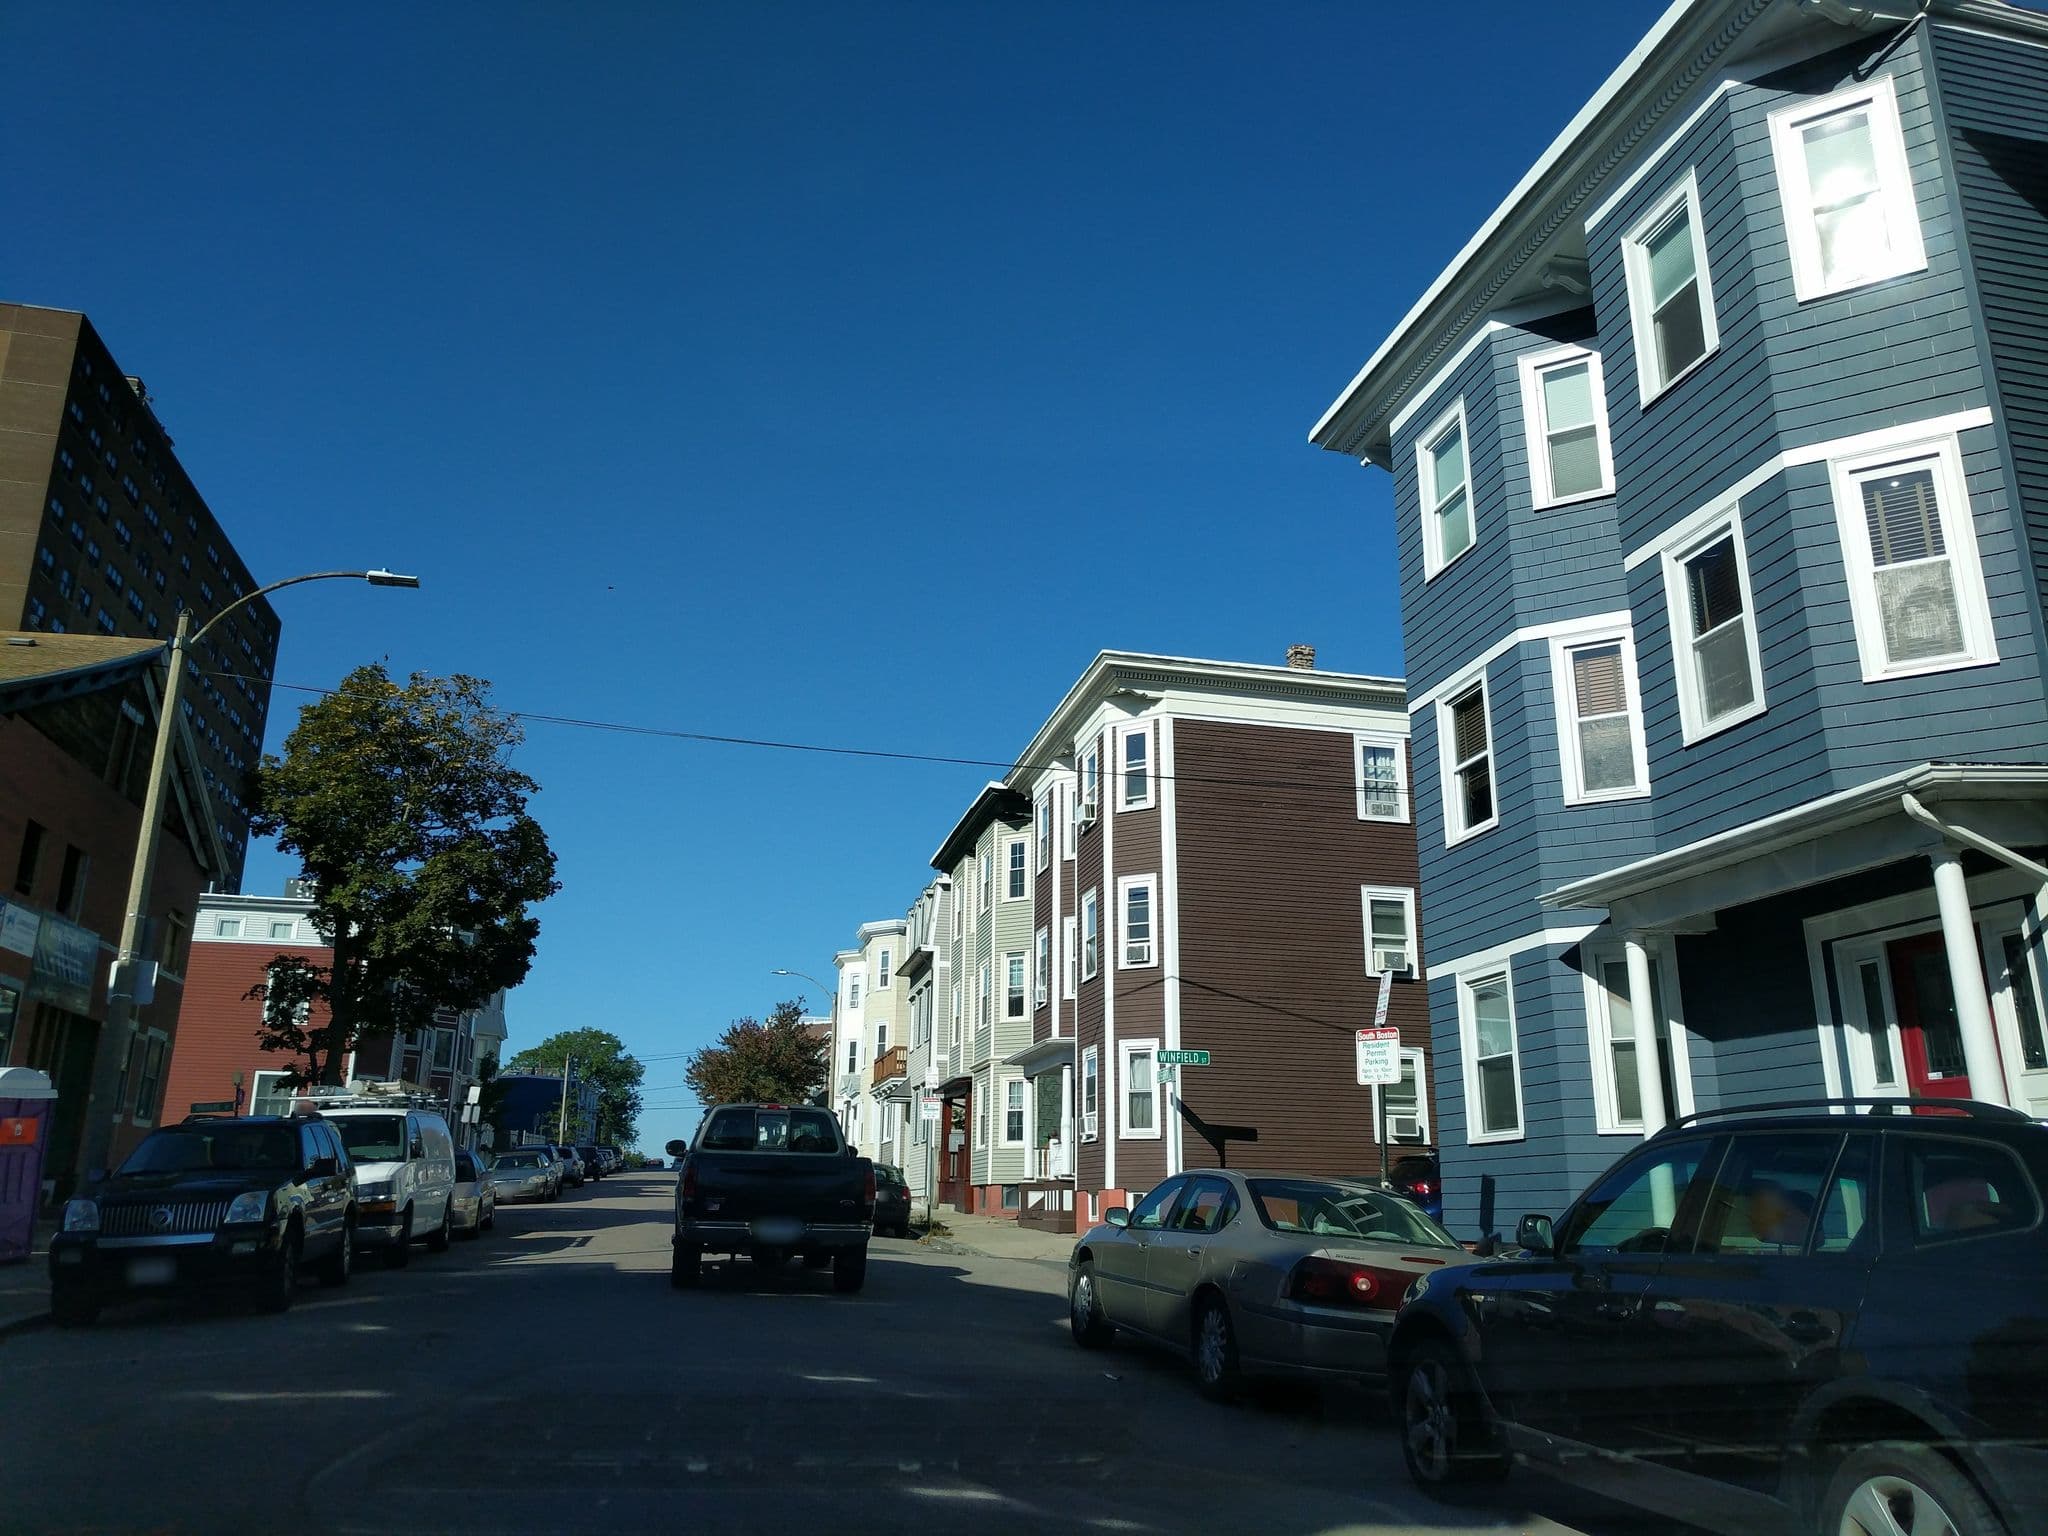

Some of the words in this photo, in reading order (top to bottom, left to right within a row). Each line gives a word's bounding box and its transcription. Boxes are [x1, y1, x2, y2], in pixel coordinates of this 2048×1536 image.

[1359, 1032, 1375, 1040] South
[1376, 1031, 1397, 1039] Boston
[1362, 1041, 1390, 1049] Resident
[1159, 1051, 1199, 1063] WINFIELD
[1366, 1049, 1387, 1057] Permit
[1365, 1058, 1389, 1066] Parking
